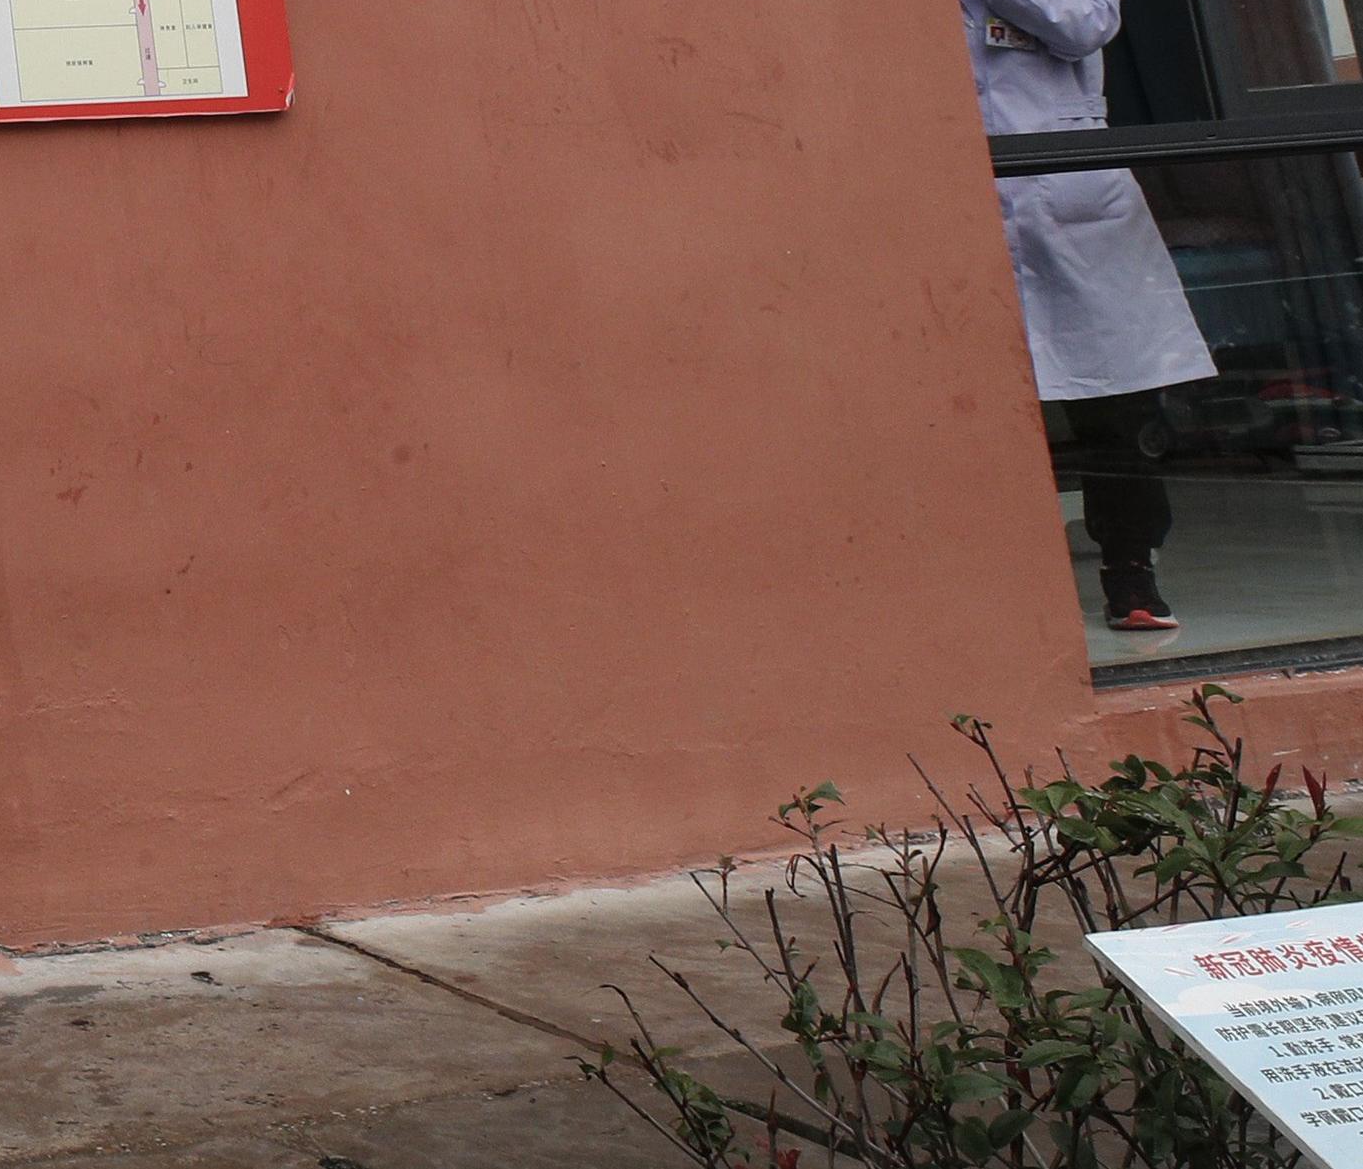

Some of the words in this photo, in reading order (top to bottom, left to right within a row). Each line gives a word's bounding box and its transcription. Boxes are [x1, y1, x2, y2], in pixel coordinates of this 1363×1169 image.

[1194, 932, 1363, 980] 新冠肺炎疫情
[1224, 987, 1363, 1018] 当前境外输入病例风
[1300, 1107, 1363, 1127] 学佩戴口
